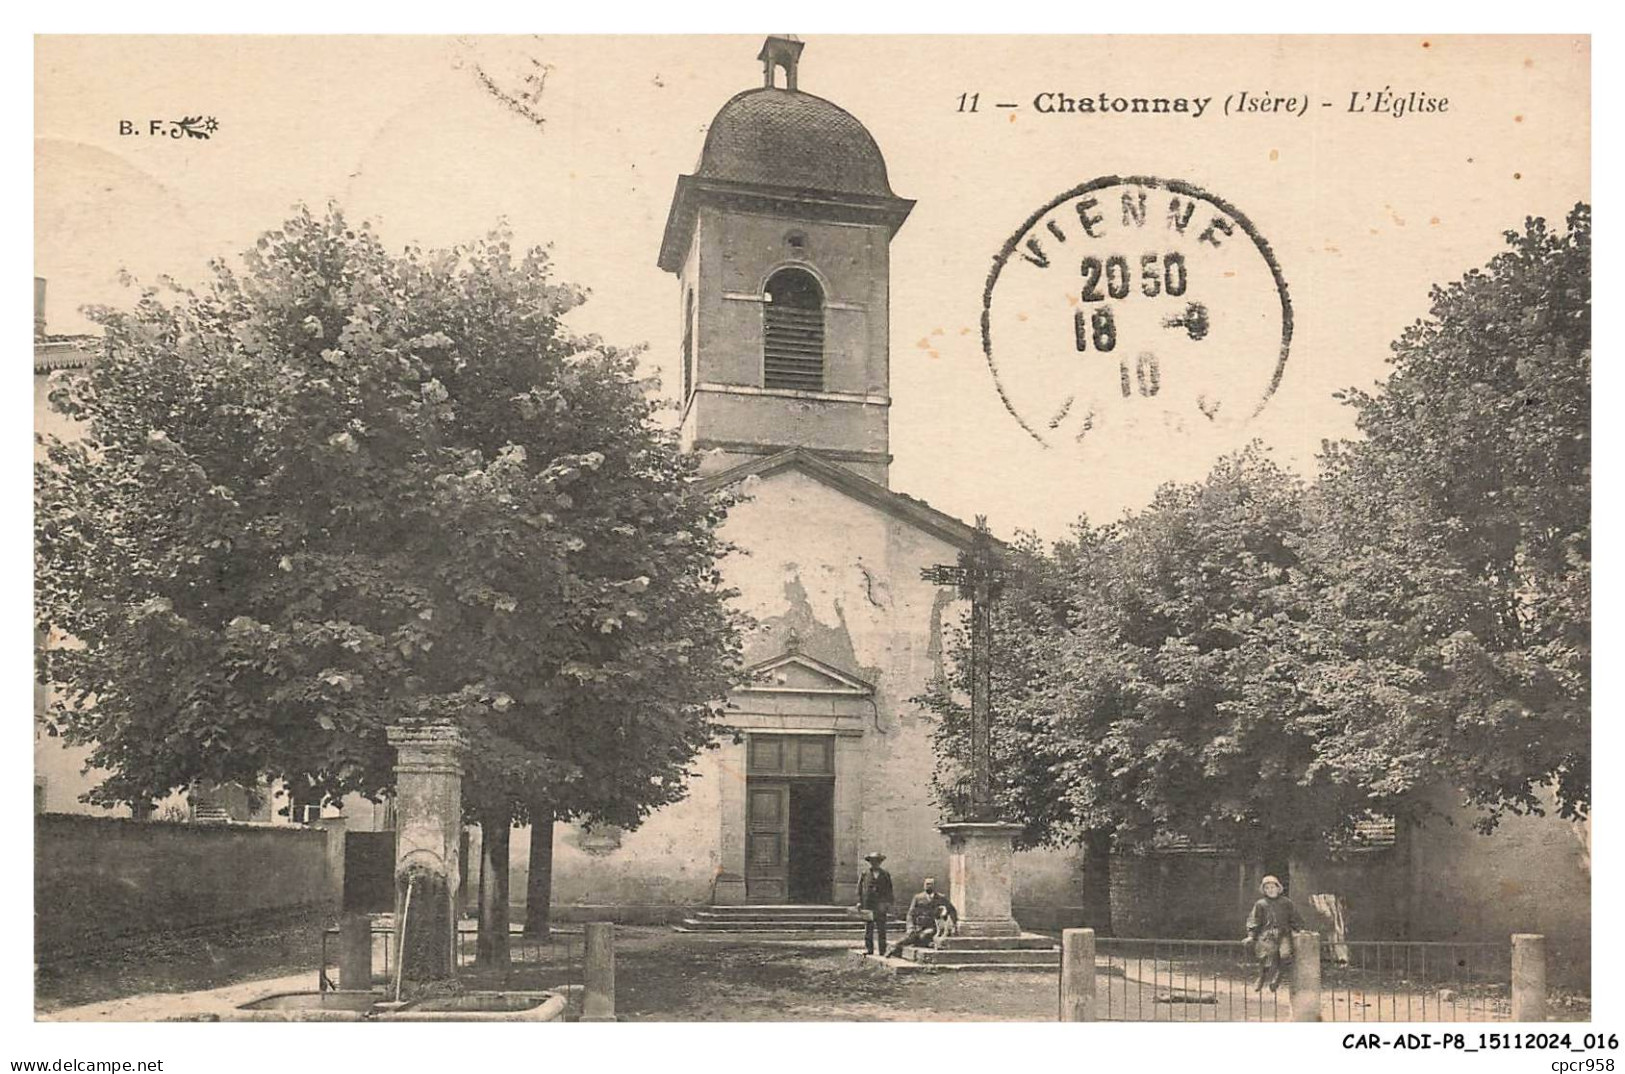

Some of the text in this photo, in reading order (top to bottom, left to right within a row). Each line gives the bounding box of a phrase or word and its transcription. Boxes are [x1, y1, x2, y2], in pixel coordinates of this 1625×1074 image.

[1020, 190, 1235, 268] VIENNE
[1080, 251, 1189, 303] 20 50
[1074, 304, 1118, 353] 18
[1119, 353, 1161, 398] 10
